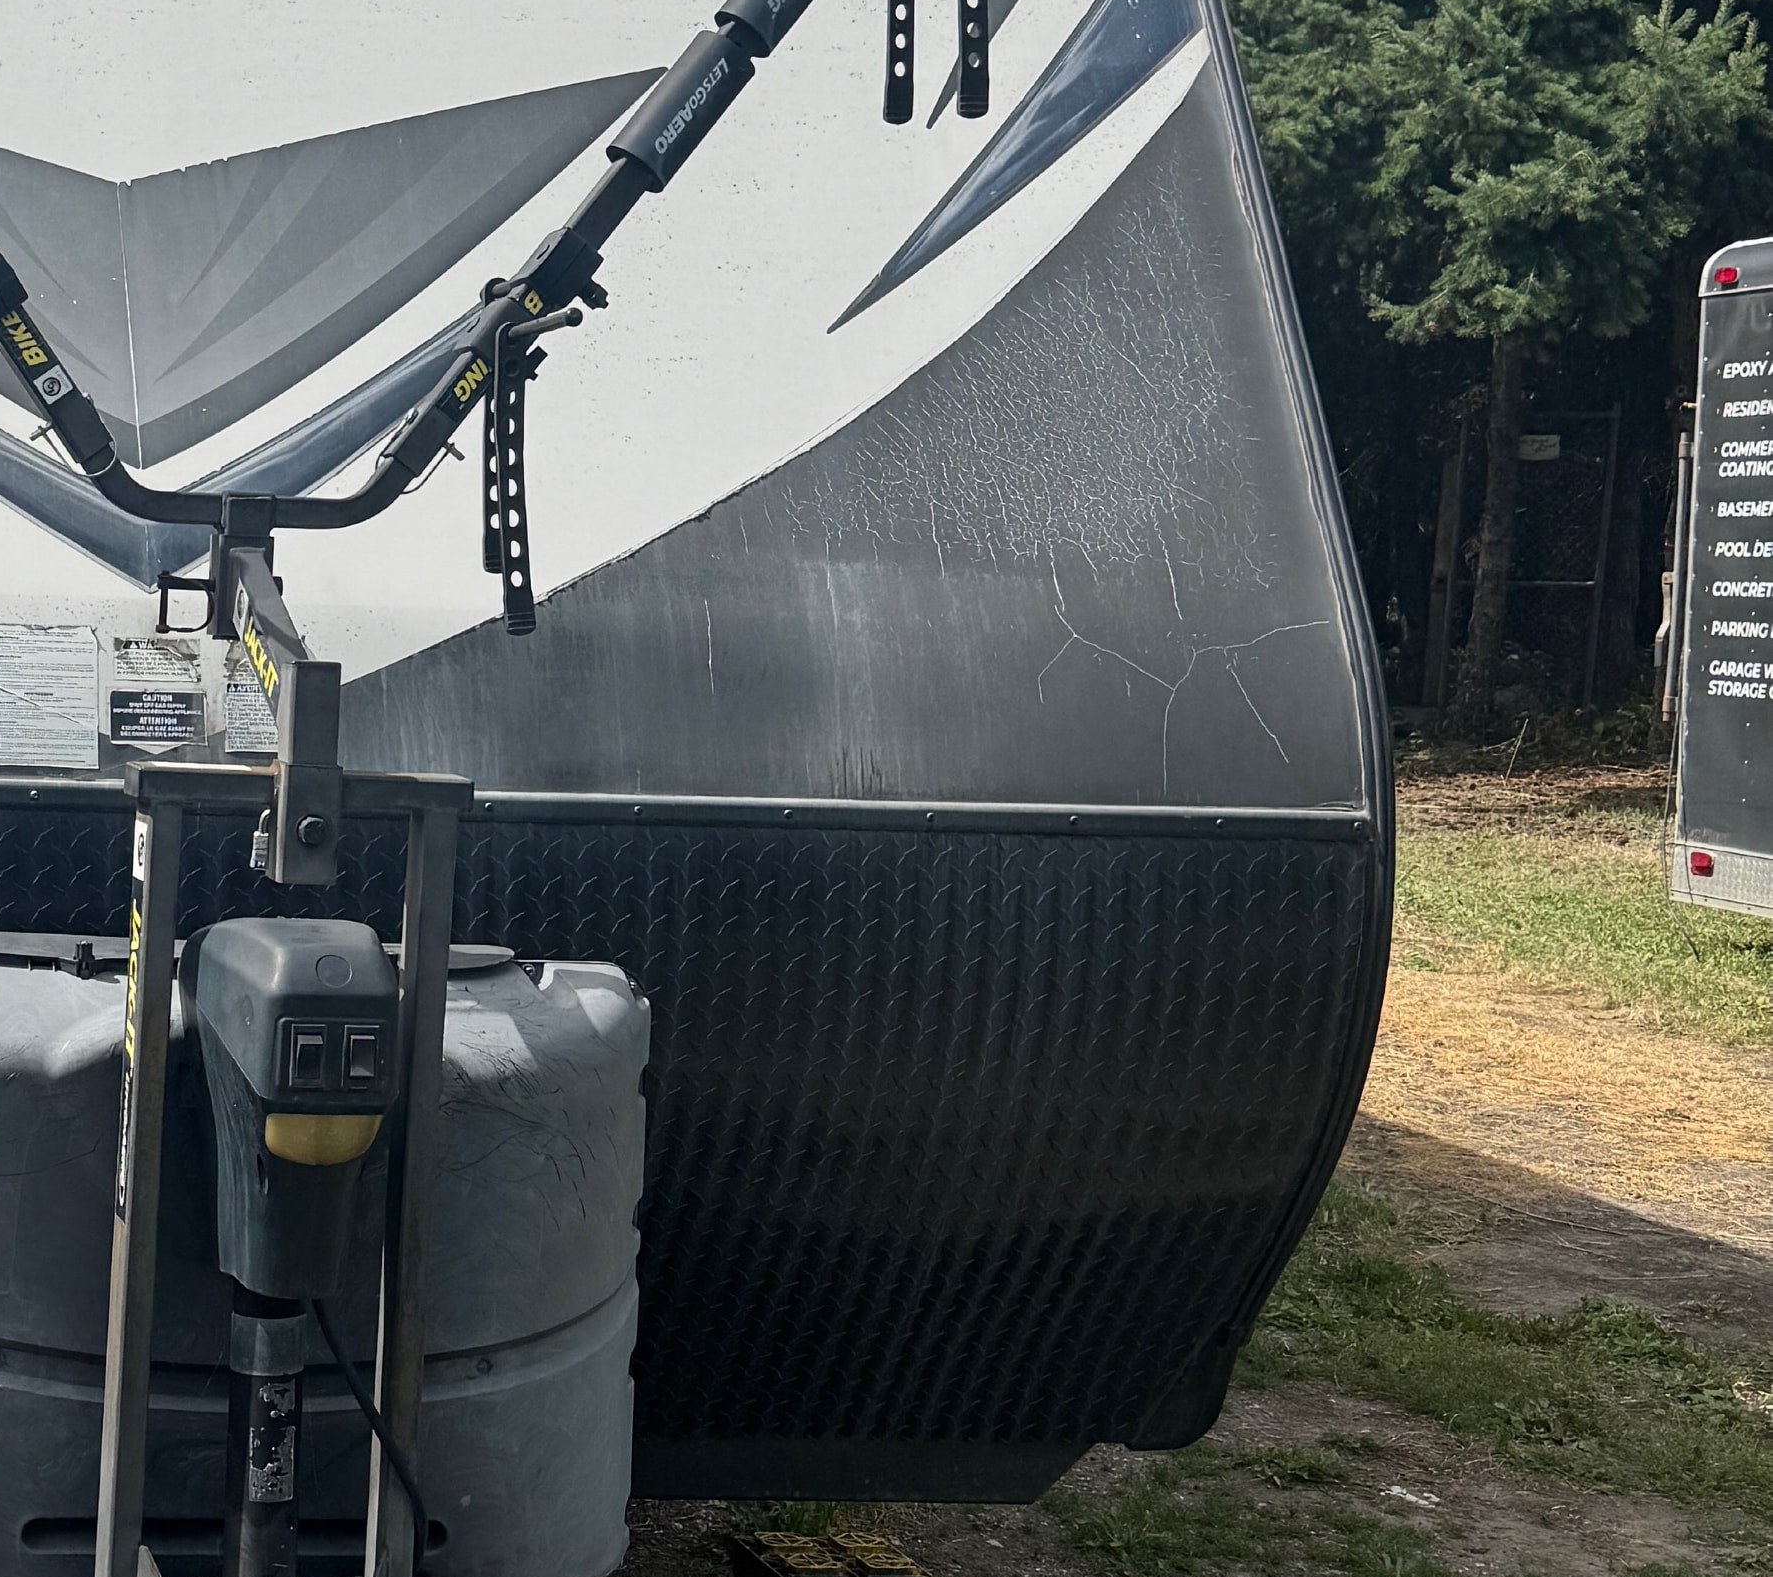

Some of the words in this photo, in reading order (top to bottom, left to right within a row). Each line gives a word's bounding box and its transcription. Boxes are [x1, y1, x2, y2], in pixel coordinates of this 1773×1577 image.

[1, 309, 49, 366] BIKE
[1723, 360, 1769, 379] EPOXY
[1715, 541, 1751, 558] POOL
[1712, 581, 1773, 597] CONCRET
[1710, 620, 1769, 639] PARKING
[1709, 659, 1762, 679] GARAGE
[1707, 680, 1767, 699] STORAGE
